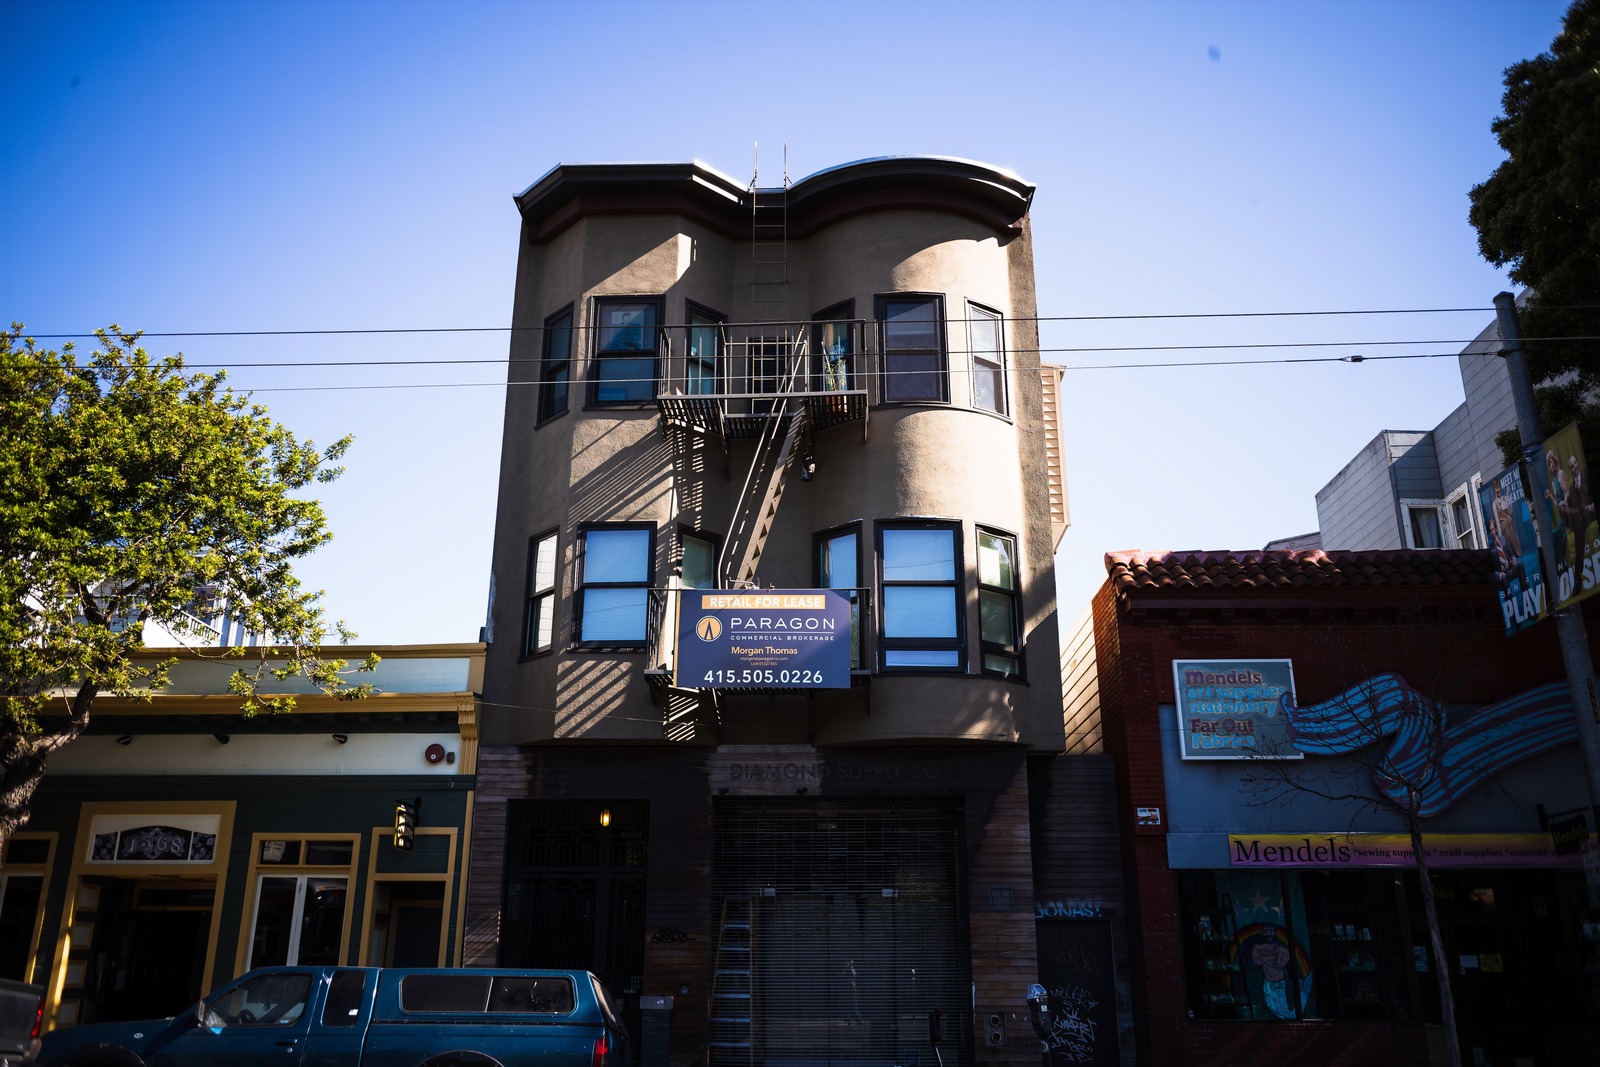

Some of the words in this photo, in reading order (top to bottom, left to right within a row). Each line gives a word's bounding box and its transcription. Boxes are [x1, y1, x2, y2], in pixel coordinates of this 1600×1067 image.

[709, 597, 750, 607] RETAIL
[755, 597, 780, 607] FOR
[784, 597, 821, 607] LEASE
[731, 617, 835, 630] PARAGON
[731, 646, 764, 656] Morgan
[765, 646, 798, 655] Thomas
[704, 670, 823, 684] 415.505.0226
[1187, 686, 1213, 700] art
[1215, 683, 1286, 700] supplies
[1189, 700, 1277, 717] stationery
[1191, 719, 1218, 733] Far
[1222, 718, 1254, 733] Out
[1192, 733, 1255, 748] Fabrics
[730, 762, 830, 779] DIAMOND
[837, 761, 900, 779] SUPPLY
[128, 835, 182, 853] 1568
[1233, 838, 1351, 862] Mendels
[1440, 848, 1462, 856] craft
[1464, 848, 1503, 858] supplies
